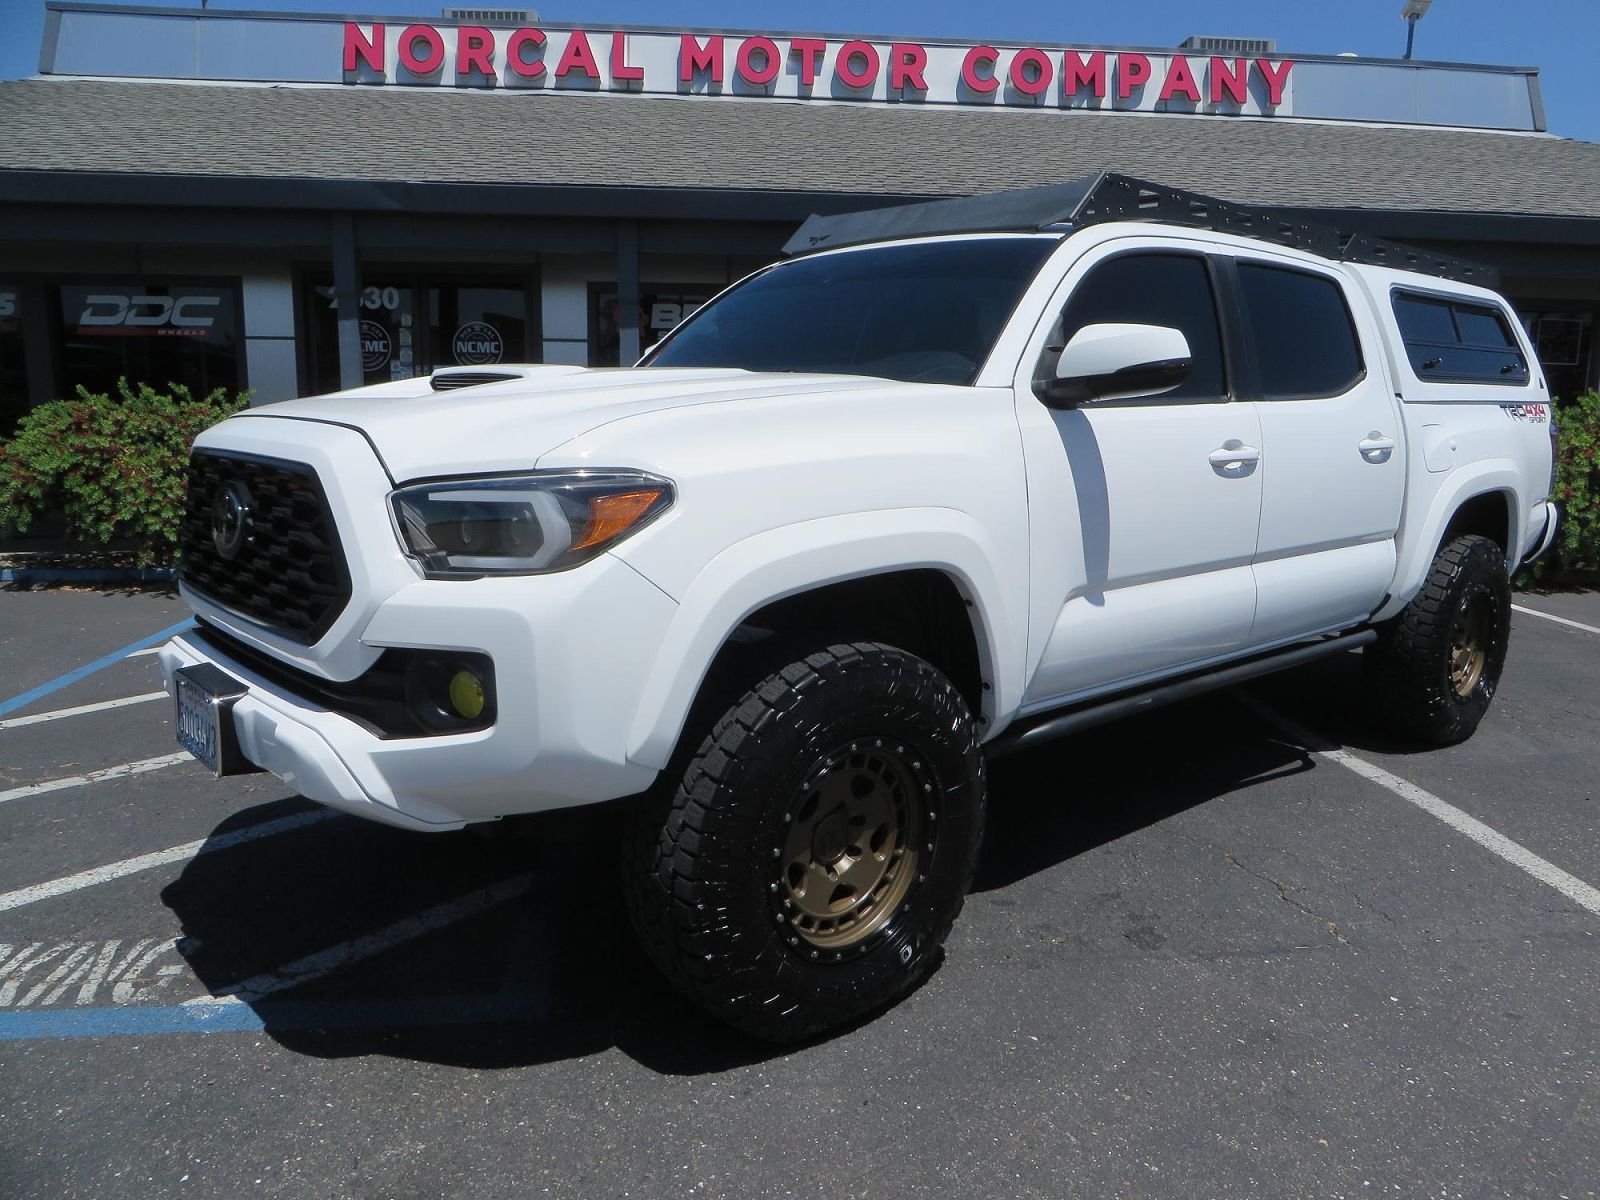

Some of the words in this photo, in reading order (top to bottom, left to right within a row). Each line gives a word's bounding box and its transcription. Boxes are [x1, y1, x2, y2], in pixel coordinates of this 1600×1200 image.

[342, 22, 644, 80] NORCAL
[680, 34, 929, 90] MOTOR
[962, 45, 1295, 105] COMPANY
[79, 294, 221, 327] DDC
[456, 341, 499, 353] NCMC
